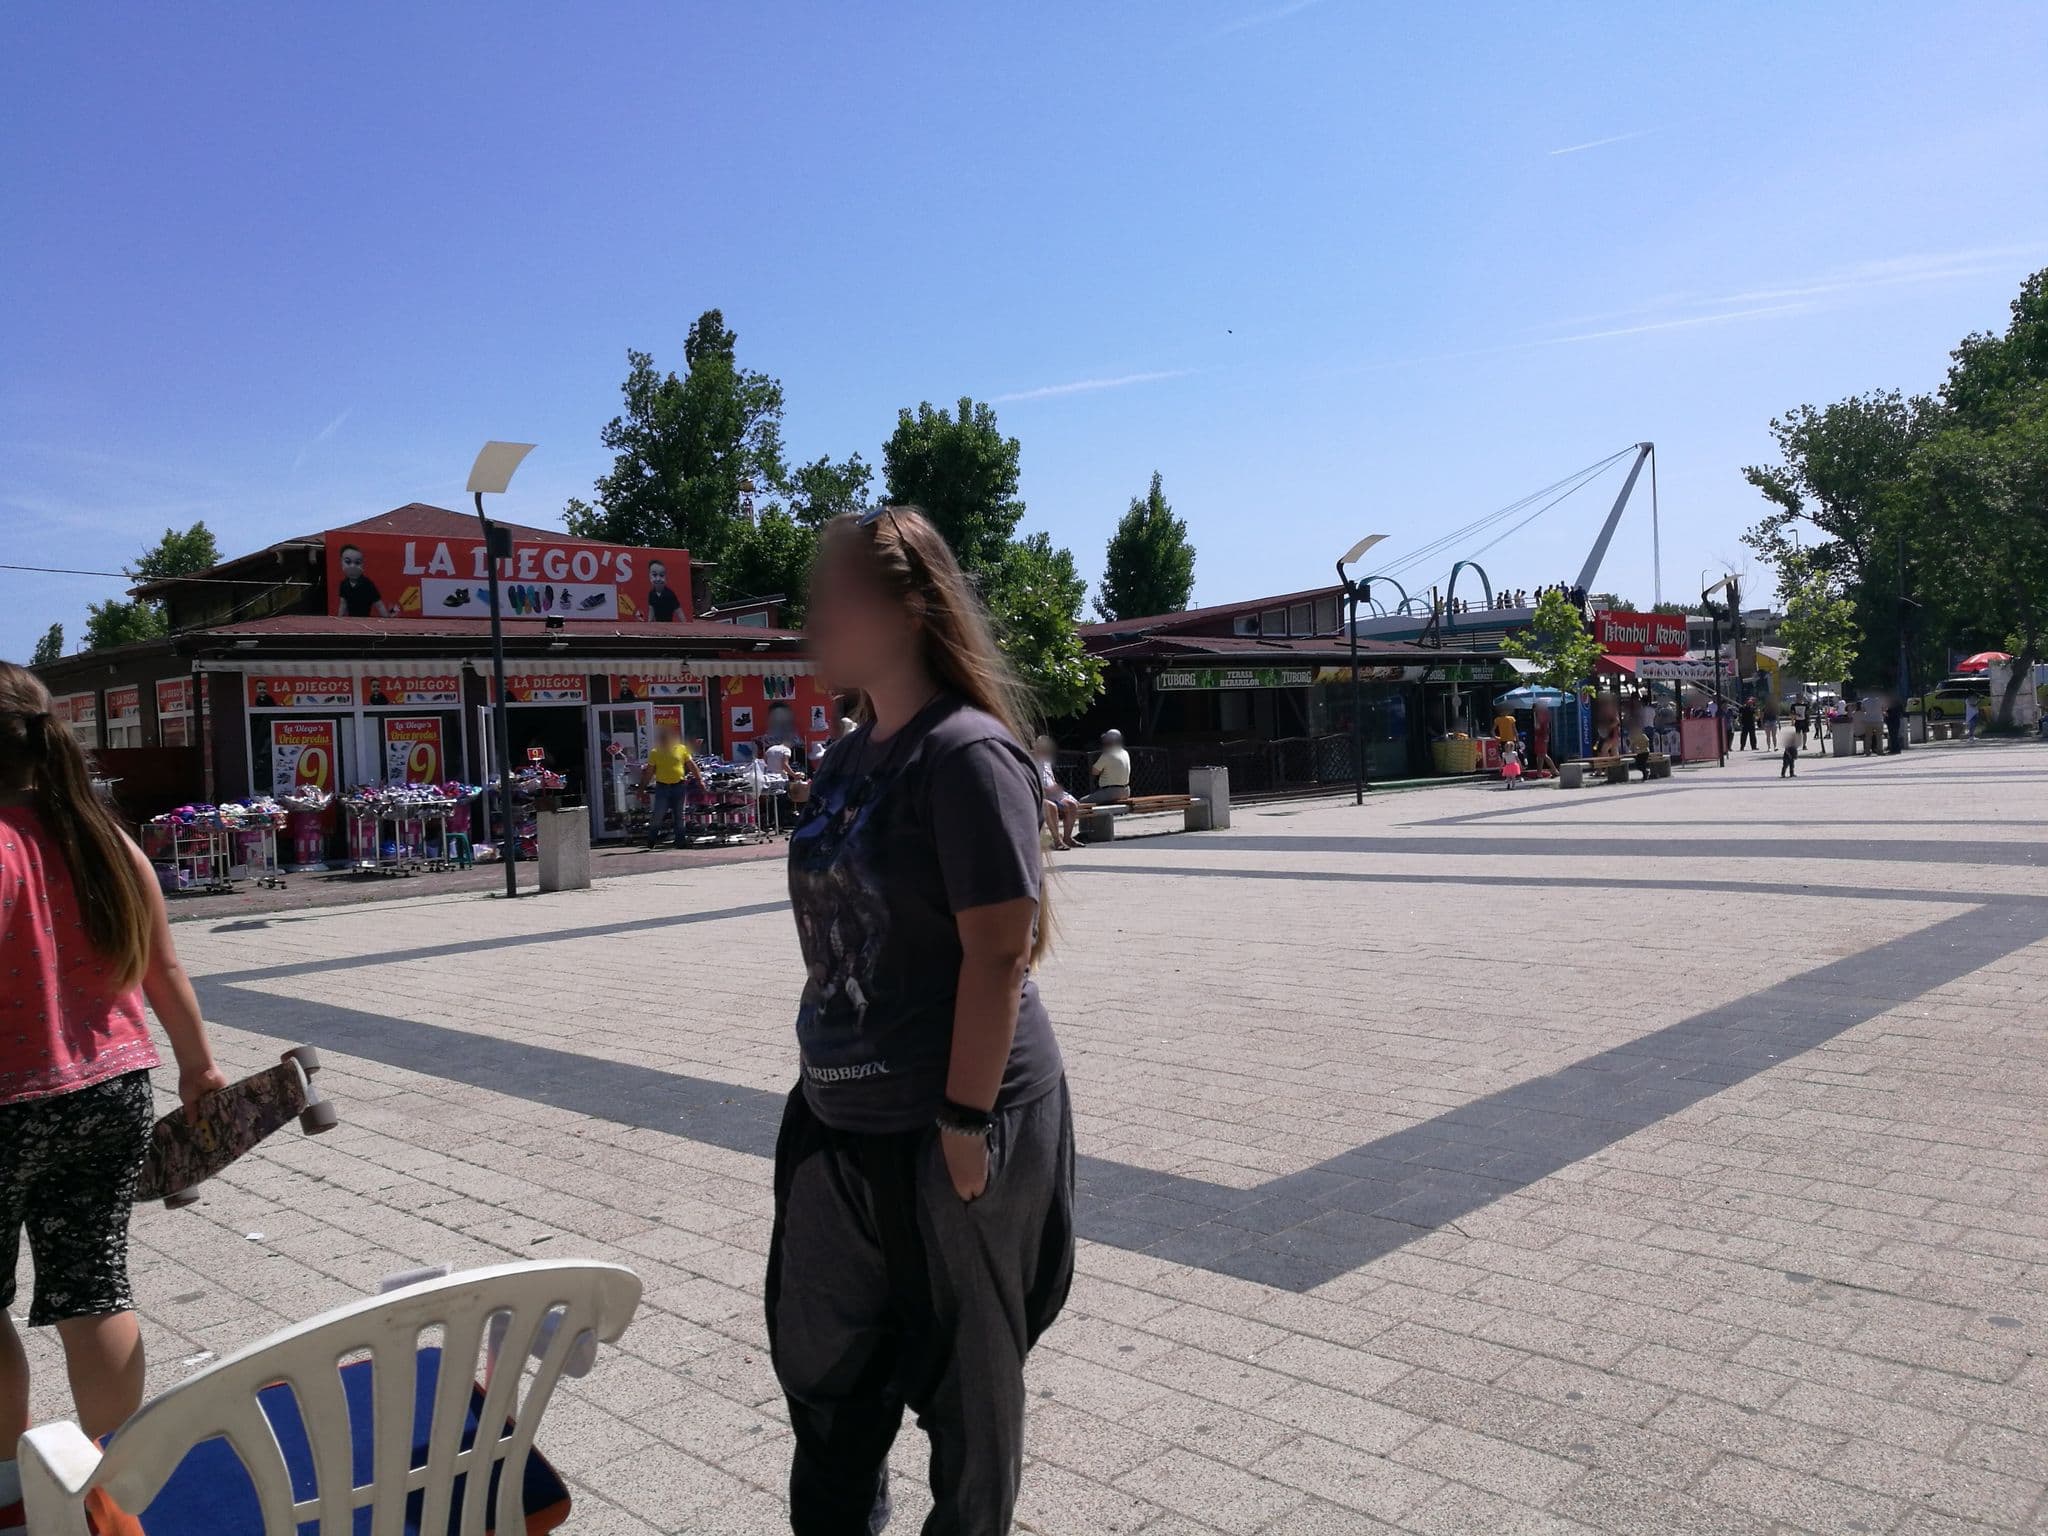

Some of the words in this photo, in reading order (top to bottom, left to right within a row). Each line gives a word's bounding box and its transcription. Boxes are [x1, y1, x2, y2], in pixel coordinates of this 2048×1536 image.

[403, 541, 456, 576] LA
[471, 546, 633, 583] DIEGO'S
[1604, 620, 1650, 643] Istanbul
[1655, 623, 1687, 649] Kebap
[514, 677, 529, 688] LA
[534, 676, 581, 688] DIEGO'S
[1161, 672, 1196, 686] TUBORG
[1281, 671, 1312, 684] TUBORG
[273, 681, 291, 692] LA
[295, 681, 350, 692] DIEGO'S
[386, 680, 402, 691] LA
[406, 679, 456, 691] DIEGO'S
[295, 724, 324, 734] Diego's
[299, 748, 328, 790] 9
[409, 743, 437, 784] 9
